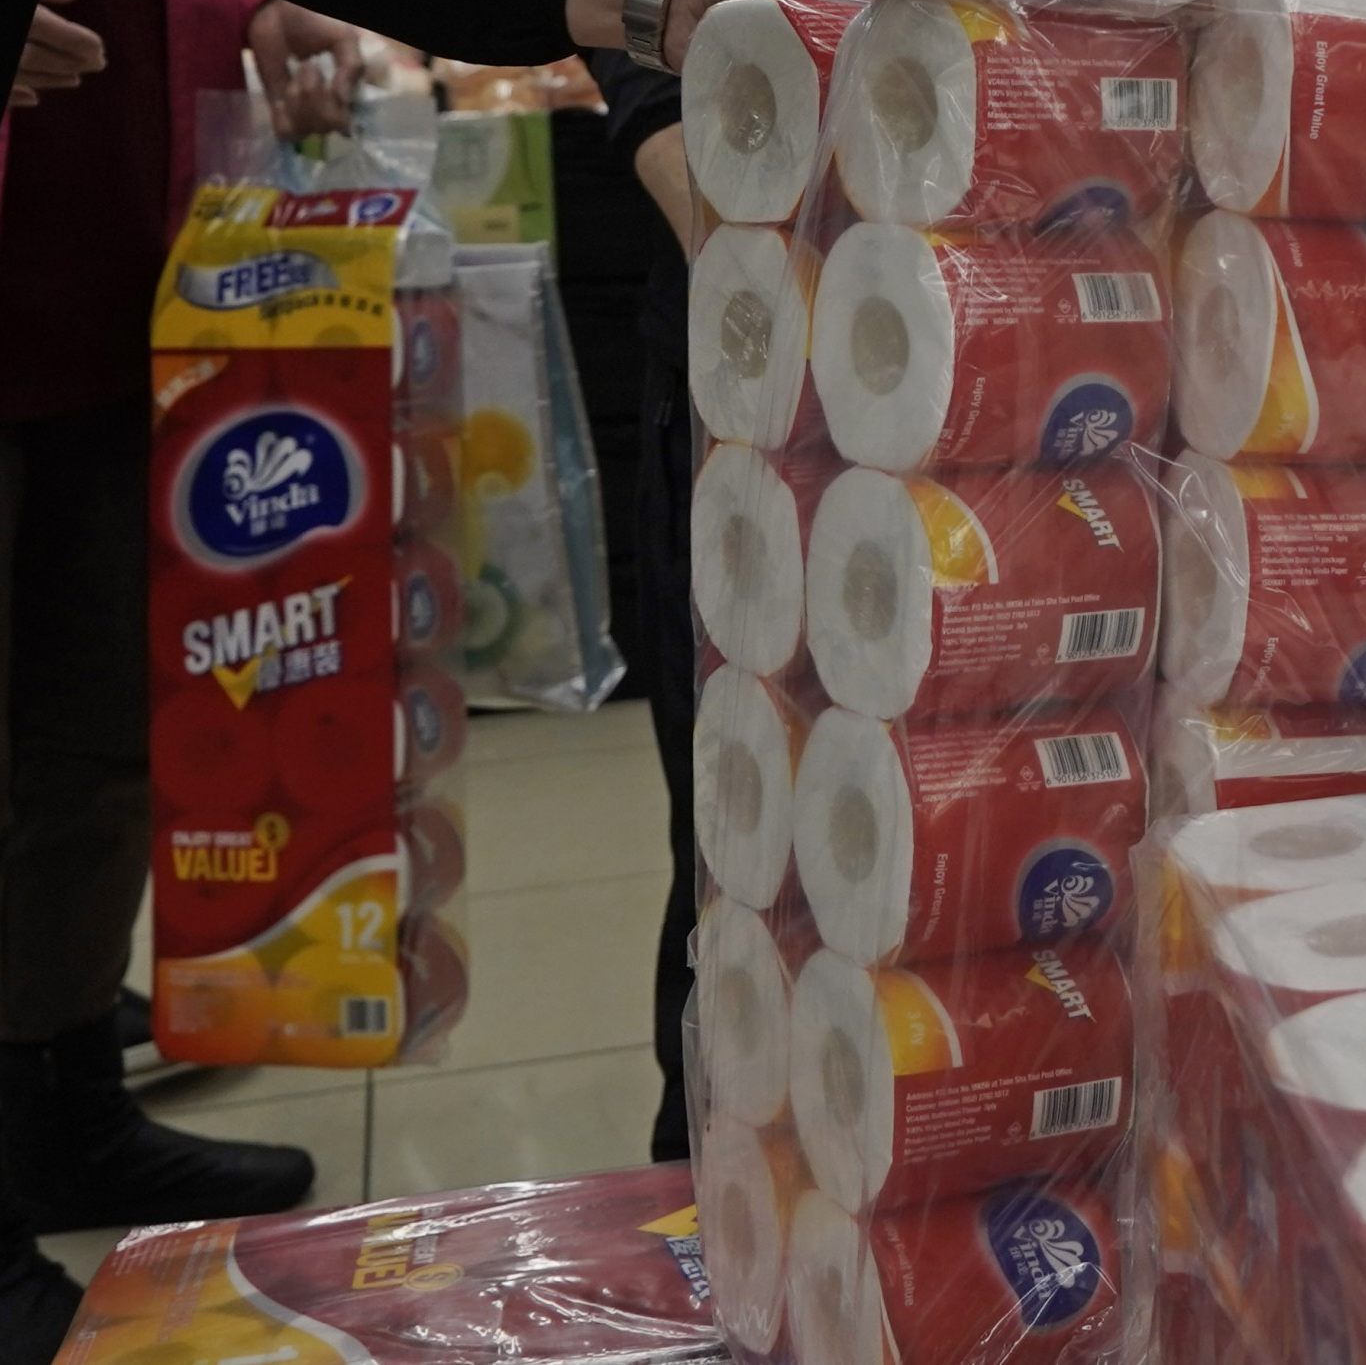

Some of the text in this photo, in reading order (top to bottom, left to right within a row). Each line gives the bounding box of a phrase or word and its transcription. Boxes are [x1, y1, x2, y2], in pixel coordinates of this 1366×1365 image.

[1309, 41, 1329, 140] Enjoy Great Value
[973, 377, 986, 409] Enjoy
[226, 482, 320, 525] Vinda
[1061, 478, 1122, 548] SMART
[183, 584, 341, 675] SMART
[1264, 637, 1279, 666] Enjoy
[934, 853, 949, 889] Enjoy
[336, 901, 385, 951] 12
[930, 888, 946, 917] Great
[1039, 878, 1059, 934] Vinda
[1031, 949, 1091, 1018] SMART
[1012, 1225, 1051, 1302] Vinda
[904, 1272, 916, 1307] Value
